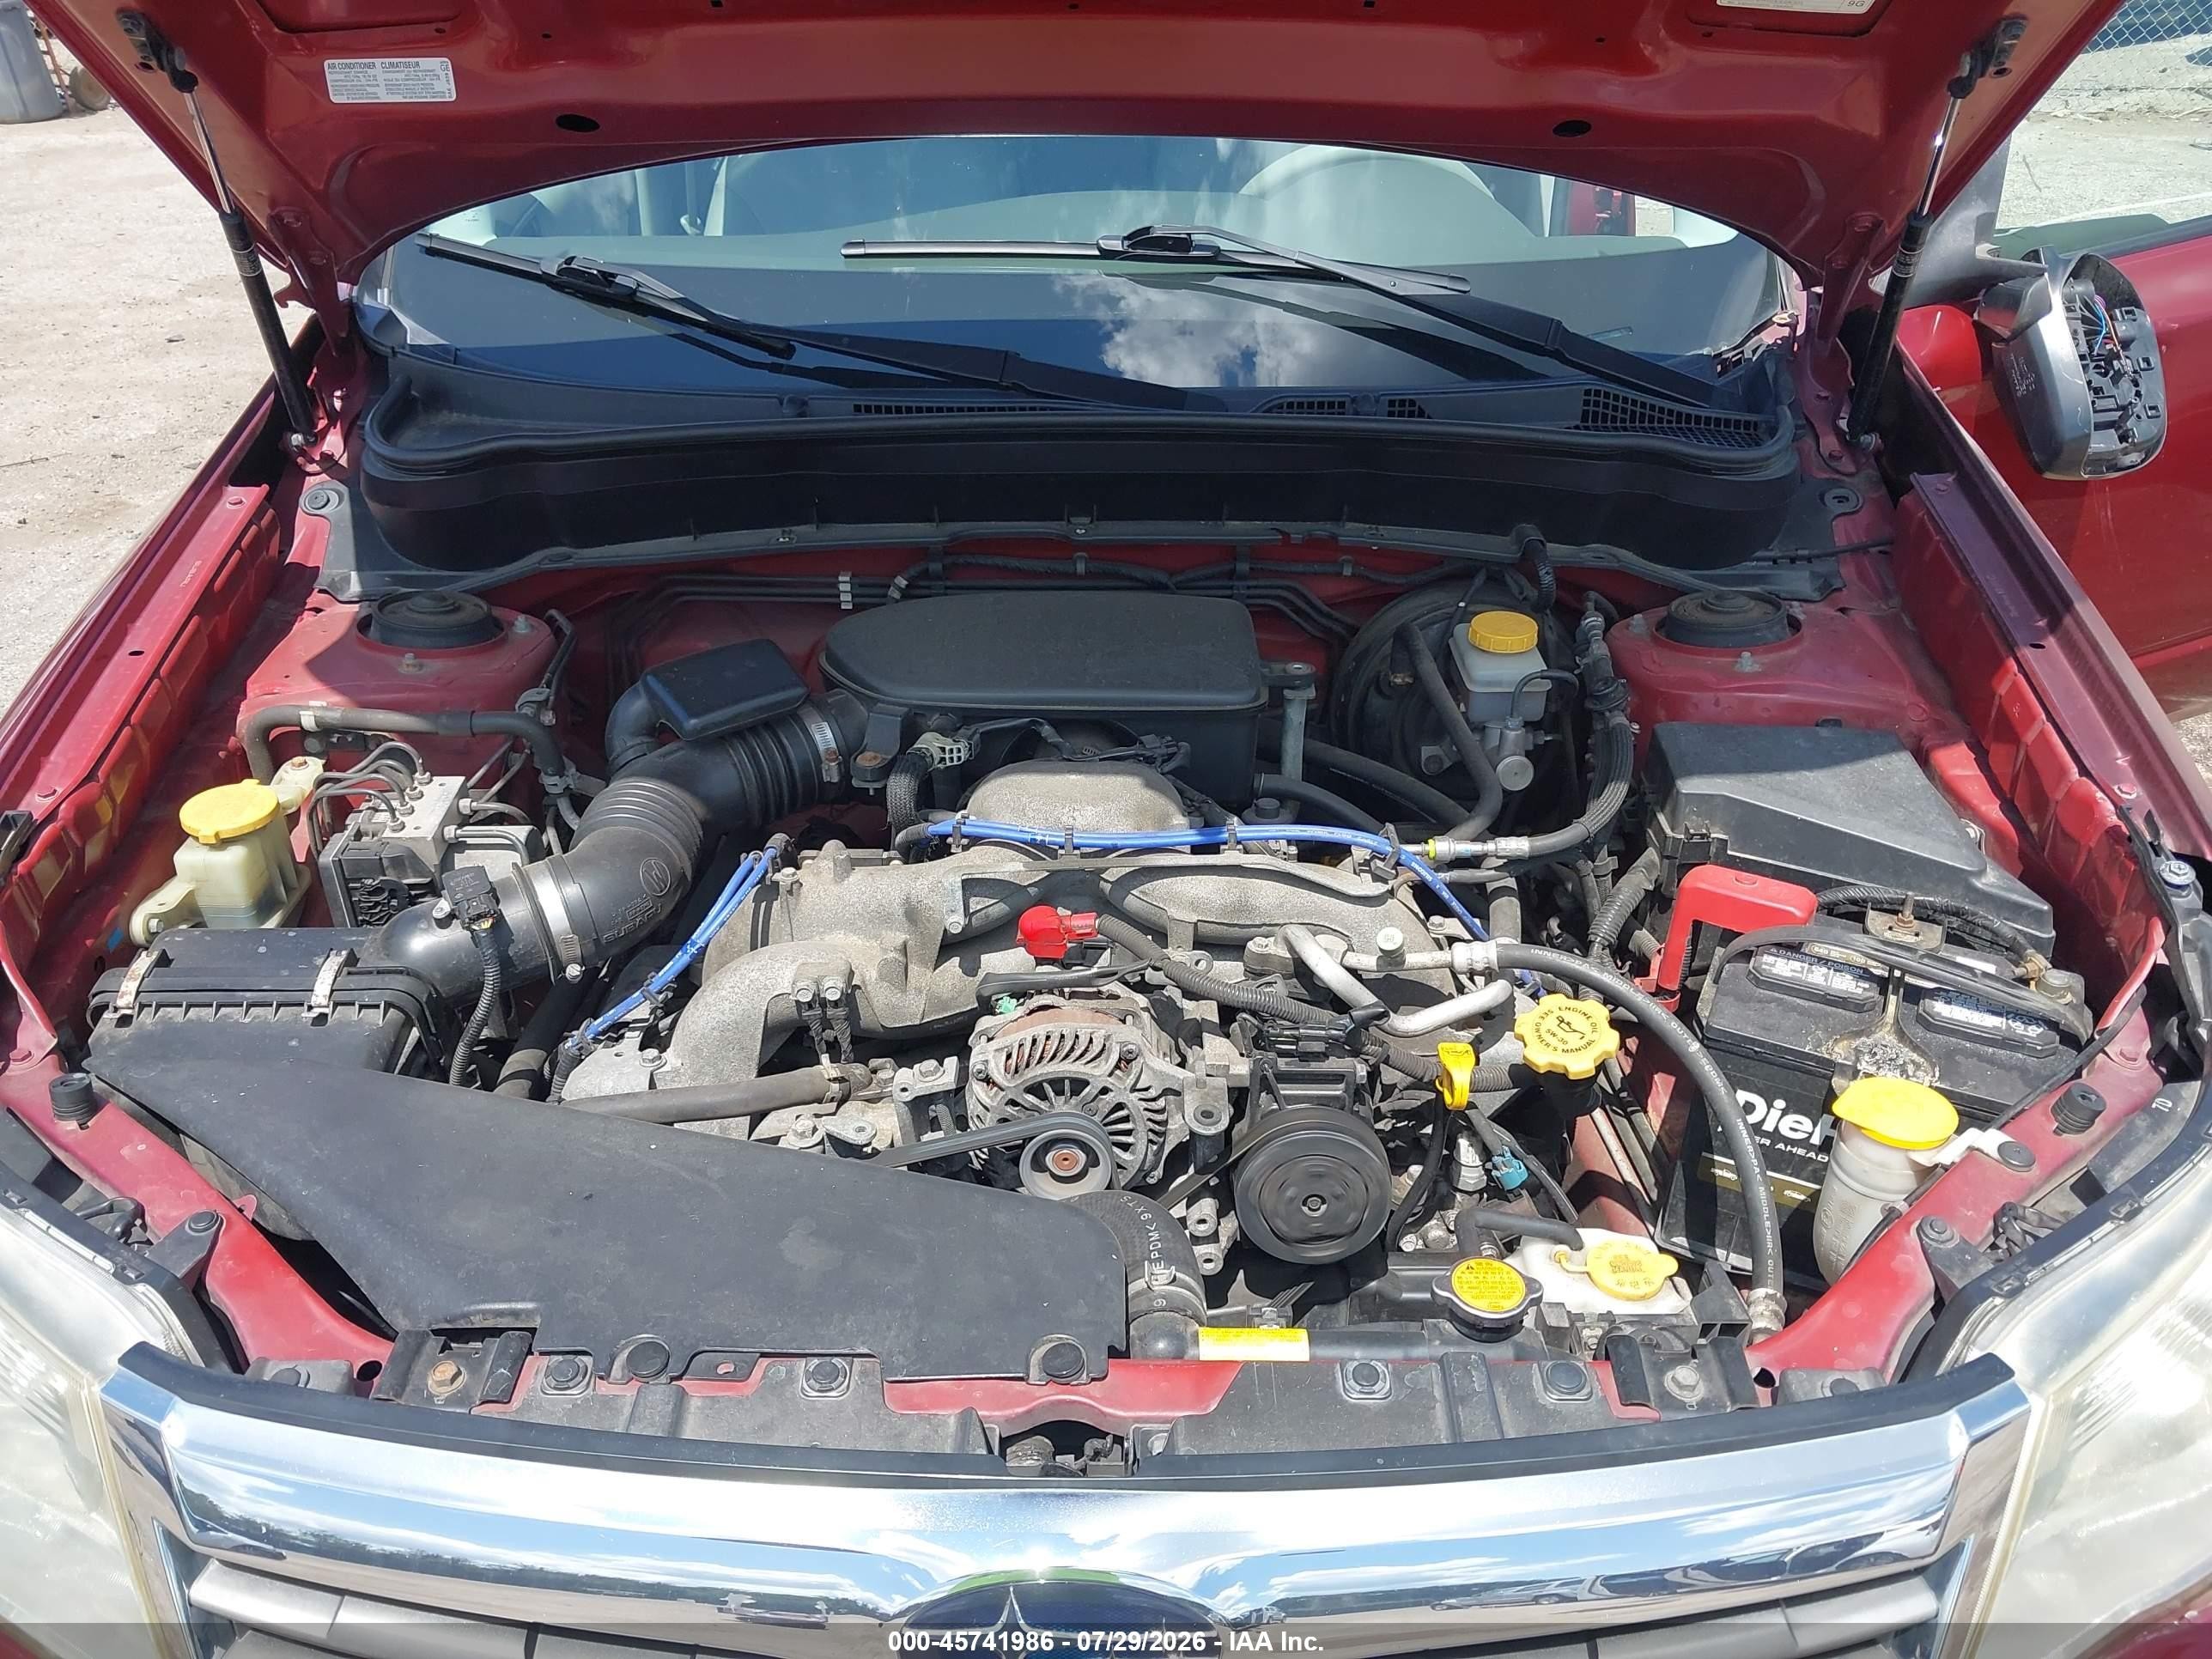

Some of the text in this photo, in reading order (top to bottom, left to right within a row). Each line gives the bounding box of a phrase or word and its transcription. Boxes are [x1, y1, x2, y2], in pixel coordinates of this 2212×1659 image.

[327, 61, 377, 70] AIR CONDITIONER
[380, 60, 421, 70] CLIMATISEUR
[603, 902, 661, 944] SUBARU
[1778, 949, 1818, 964] DANGER
[1827, 961, 1864, 975] POISON
[1539, 1009, 1554, 1021] SEE
[1558, 1006, 1599, 1034] ENGINE OIL
[1545, 1028, 1569, 1046] 5W-30
[1561, 1038, 1595, 1054] MANUAL
[1774, 1143, 1829, 1163] AHEAD
